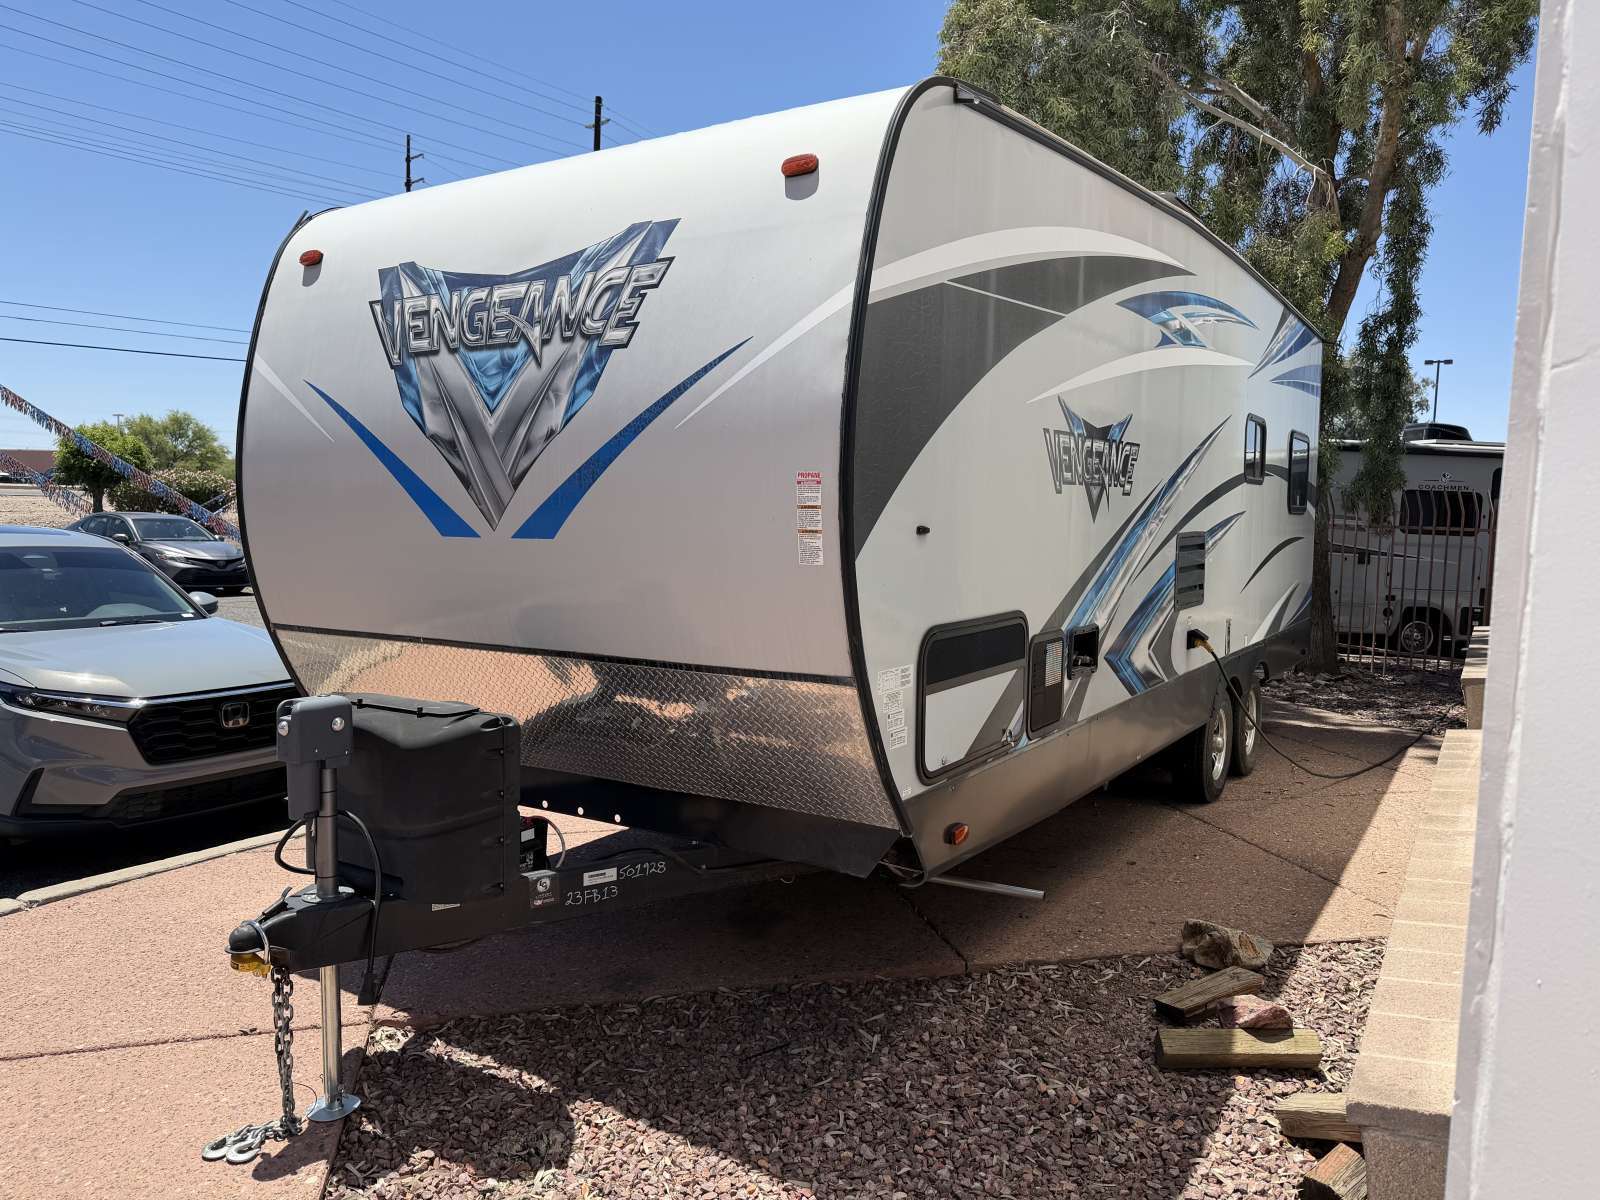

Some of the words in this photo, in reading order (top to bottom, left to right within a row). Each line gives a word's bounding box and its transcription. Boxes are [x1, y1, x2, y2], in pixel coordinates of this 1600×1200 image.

[369, 256, 676, 369] VENGEANCE
[1043, 428, 1140, 512] VENGEANCE
[565, 885, 618, 906] 23FB13
[619, 861, 666, 880] 501928
